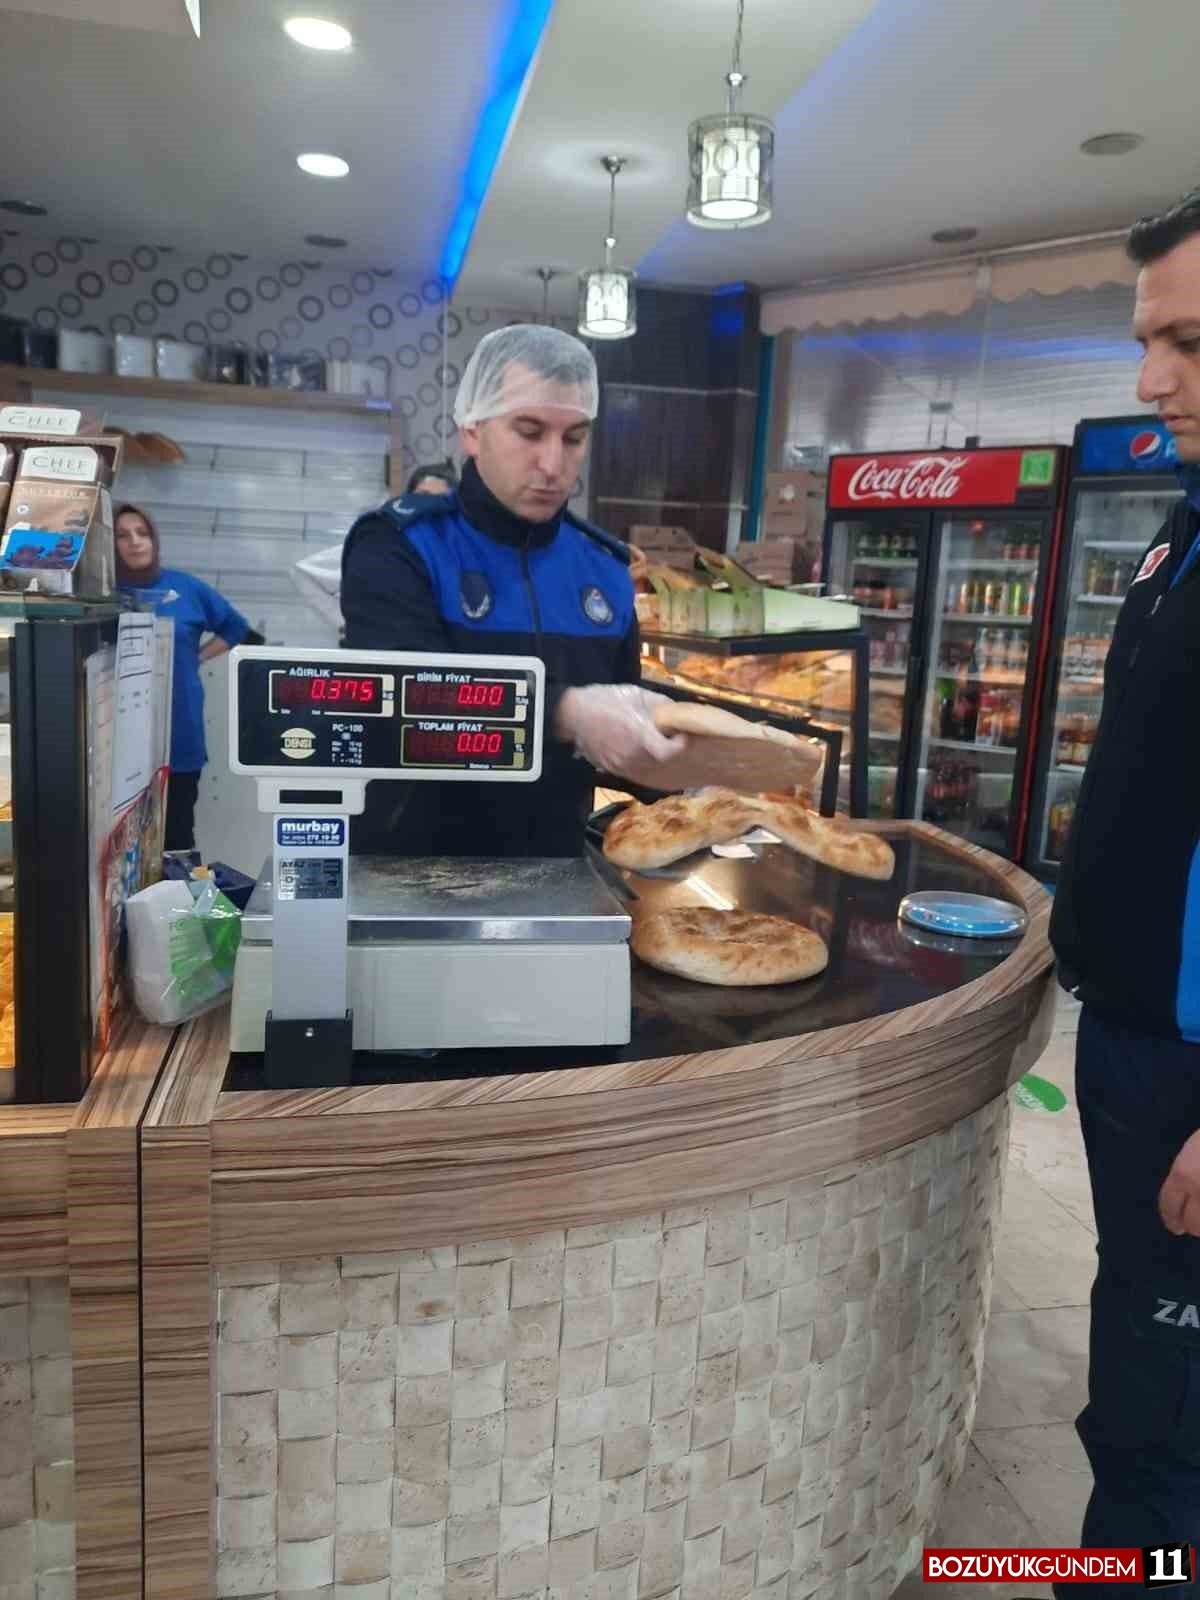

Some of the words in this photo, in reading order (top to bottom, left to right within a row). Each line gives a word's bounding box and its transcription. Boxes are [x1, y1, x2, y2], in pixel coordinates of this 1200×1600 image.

[289, 667, 331, 678] AĞIRLIK
[445, 674, 471, 684] FİYAT
[418, 722, 454, 731] TOPLAM
[457, 722, 483, 733] FİYAT
[281, 820, 340, 834] murbay
